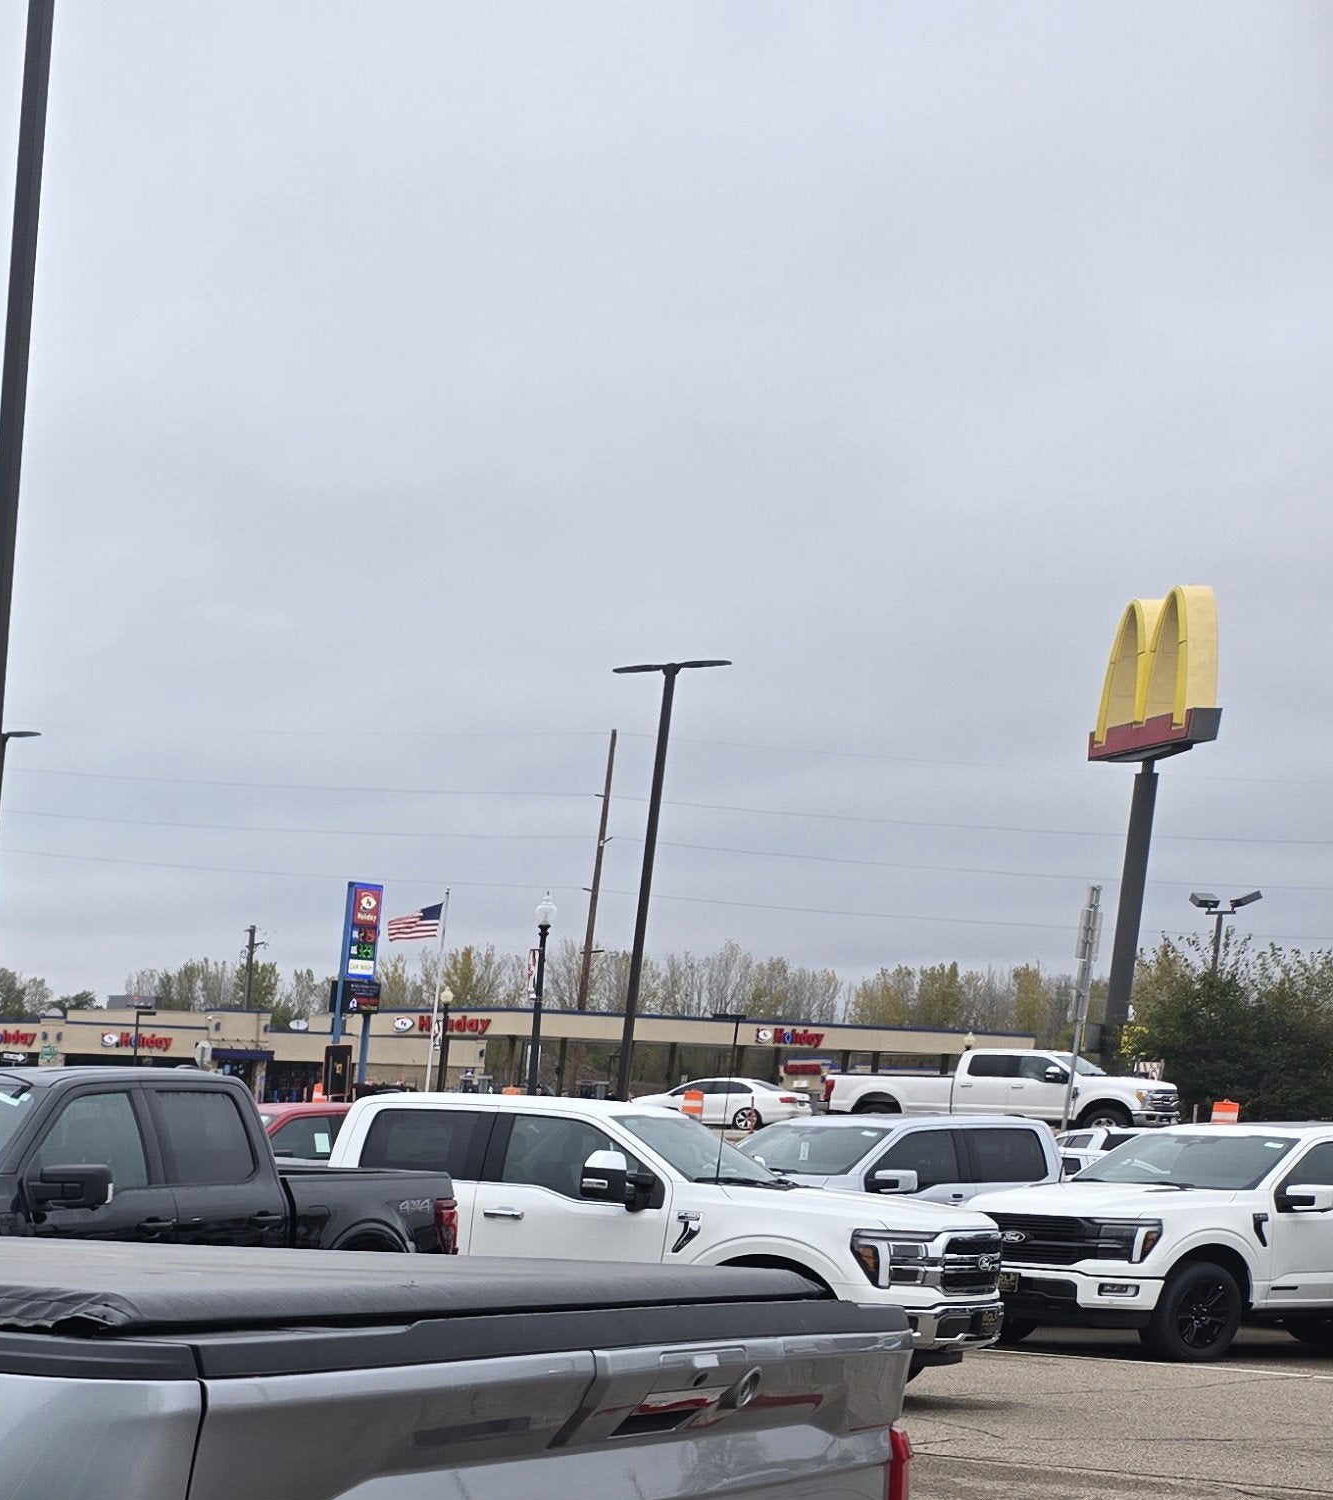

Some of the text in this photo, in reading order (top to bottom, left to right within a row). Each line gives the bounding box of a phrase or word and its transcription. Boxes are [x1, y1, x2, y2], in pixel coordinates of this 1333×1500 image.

[418, 1014, 492, 1035] Hiday
[120, 1031, 173, 1050] Holiday
[773, 1027, 825, 1049] Holiday
